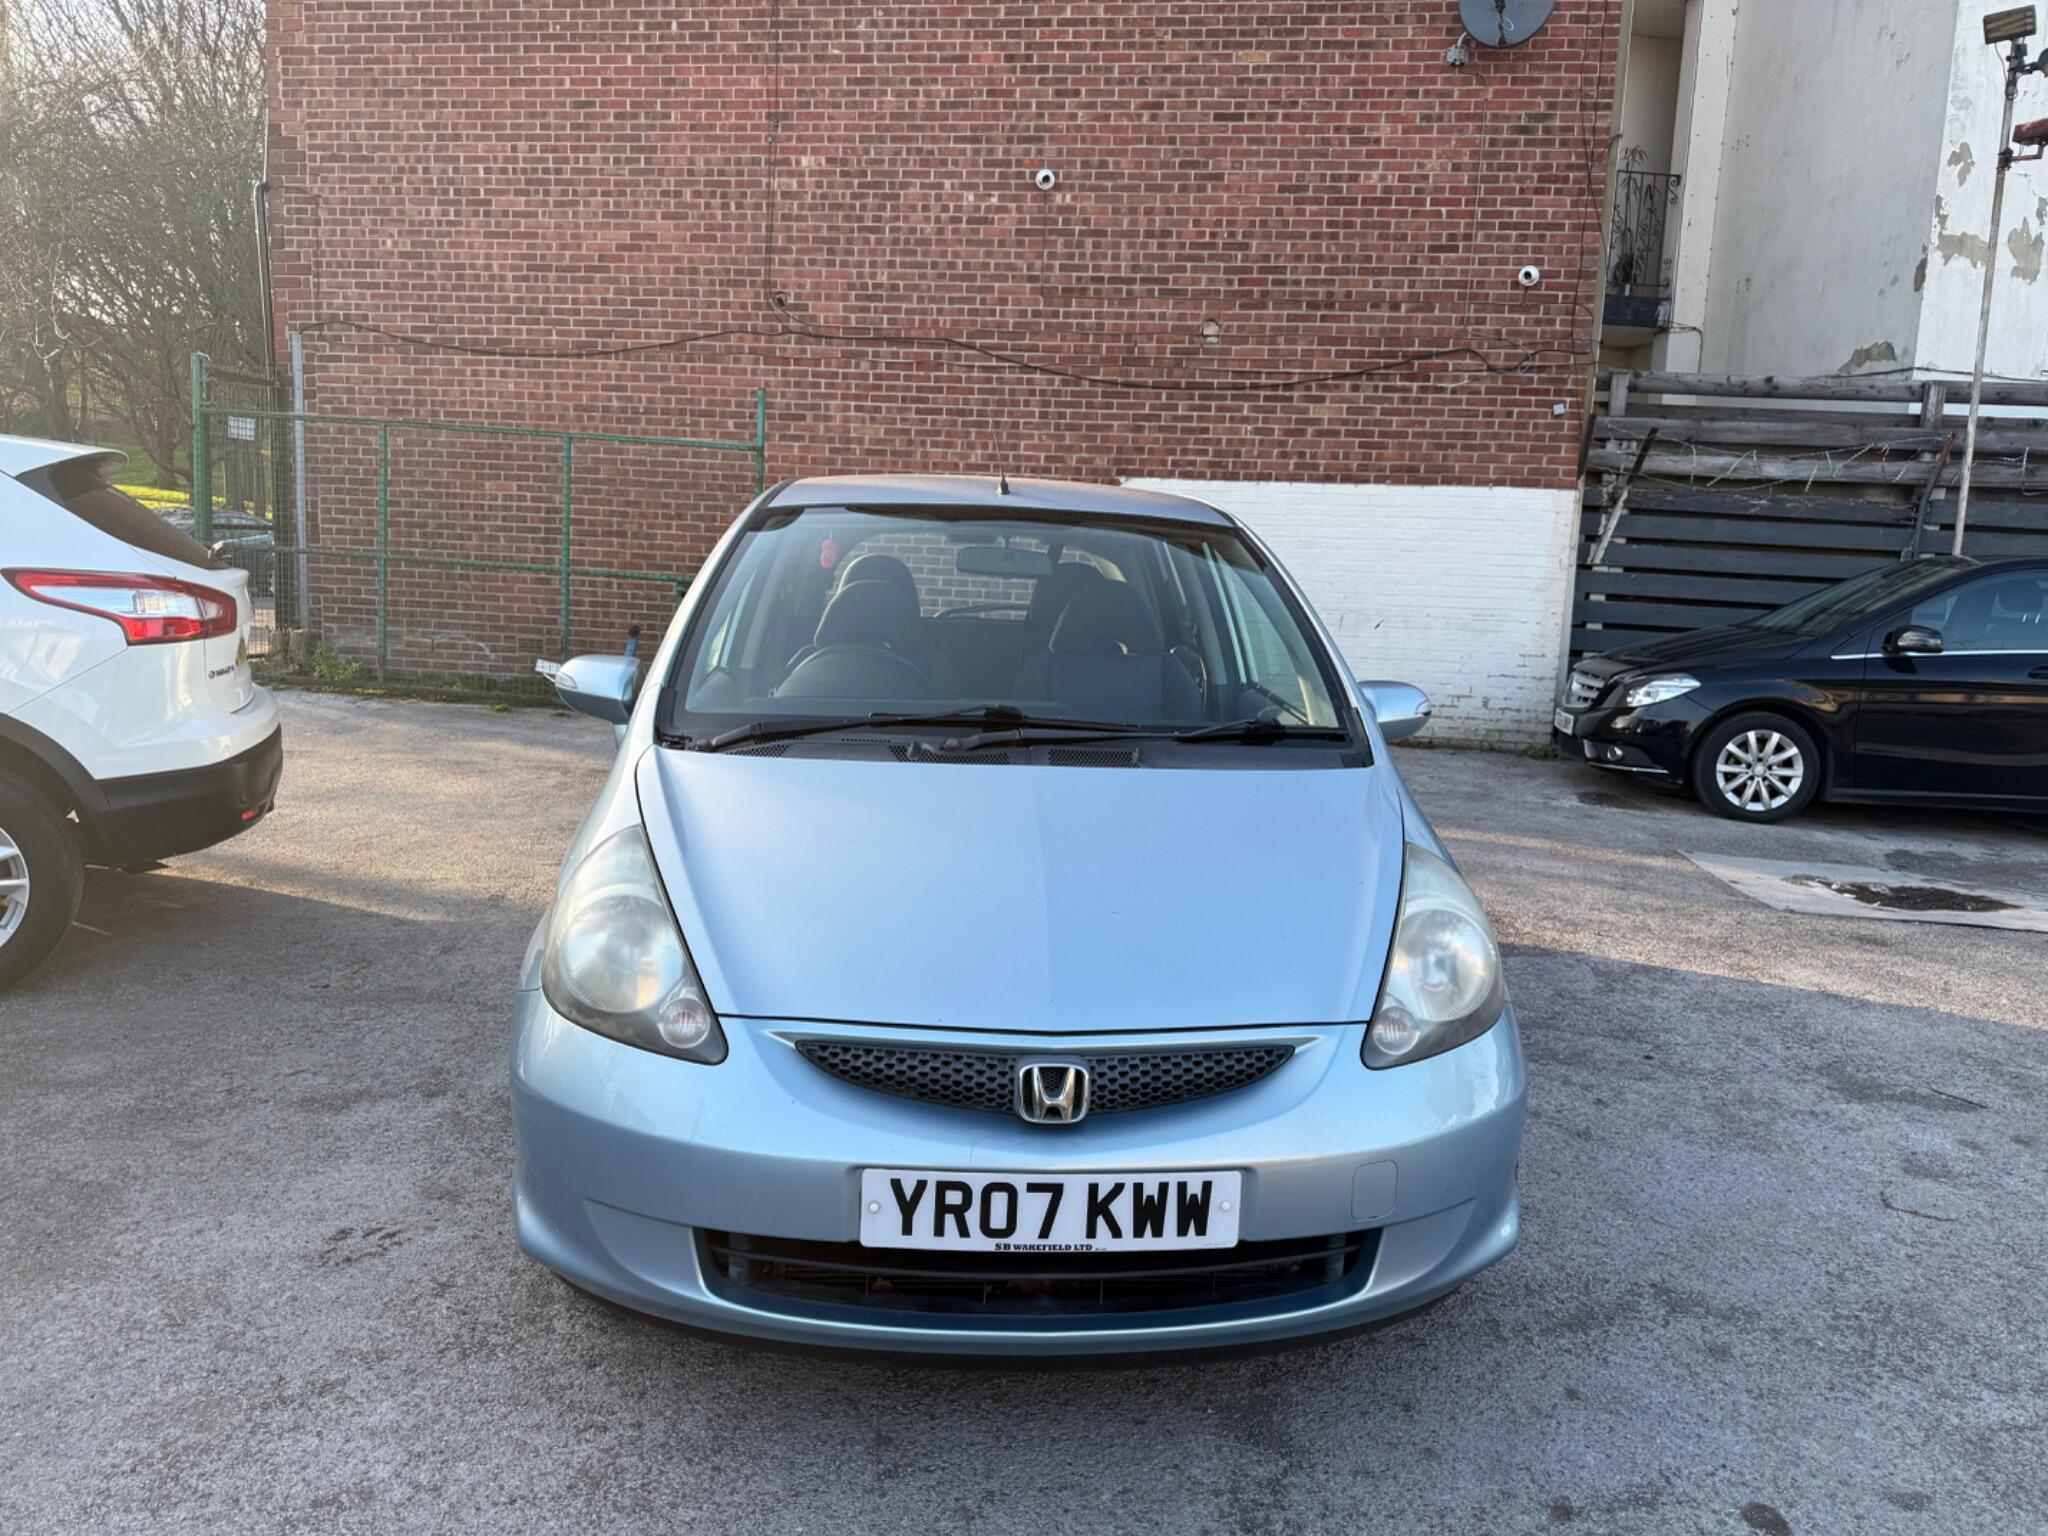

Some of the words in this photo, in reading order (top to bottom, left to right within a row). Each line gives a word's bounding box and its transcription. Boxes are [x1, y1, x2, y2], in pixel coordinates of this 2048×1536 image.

[890, 1178, 1064, 1239] YR07
[1086, 1180, 1213, 1239] KWW
[1013, 1243, 1072, 1251] WAKEFIELD
[1073, 1243, 1093, 1251] LTD
